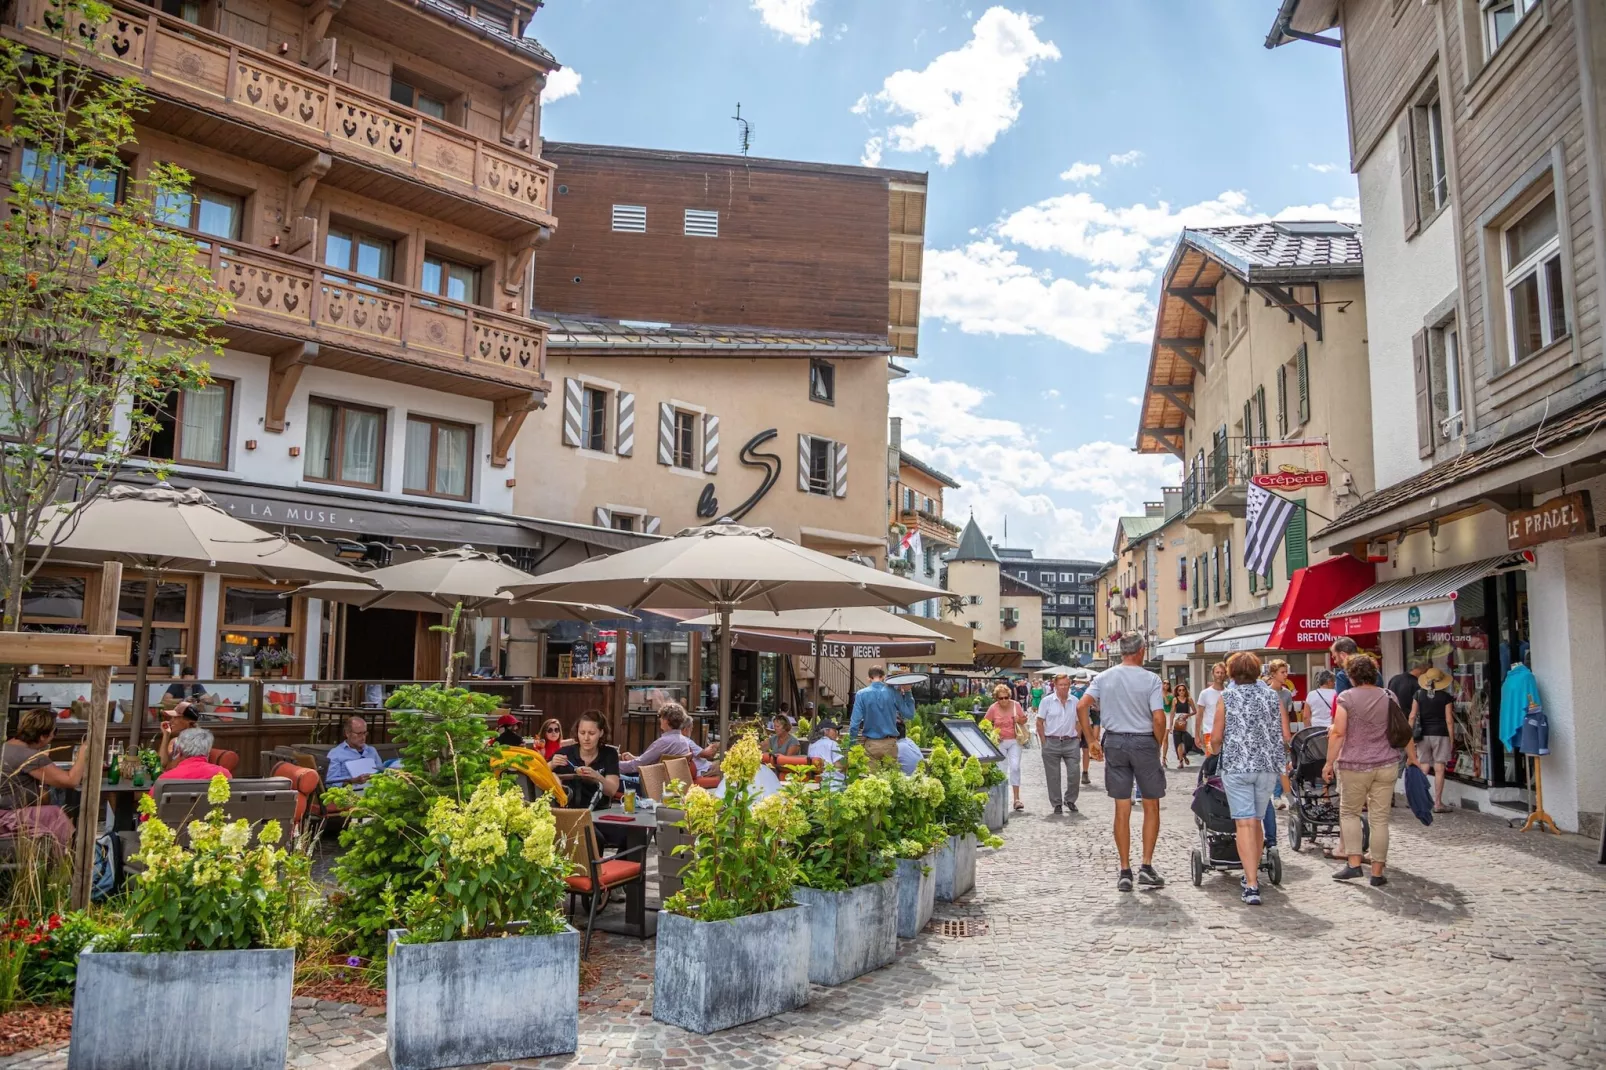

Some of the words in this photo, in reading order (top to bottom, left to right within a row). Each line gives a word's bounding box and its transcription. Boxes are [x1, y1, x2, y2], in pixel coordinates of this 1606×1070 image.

[1258, 473, 1324, 487] Crêperie
[250, 503, 273, 517] LA
[287, 508, 336, 524] MUSE
[1508, 519, 1520, 540] LE
[1525, 503, 1579, 536] PRADEL
[811, 642, 828, 657] BR
[829, 644, 839, 657] LE
[852, 645, 881, 658] MEGEVE
